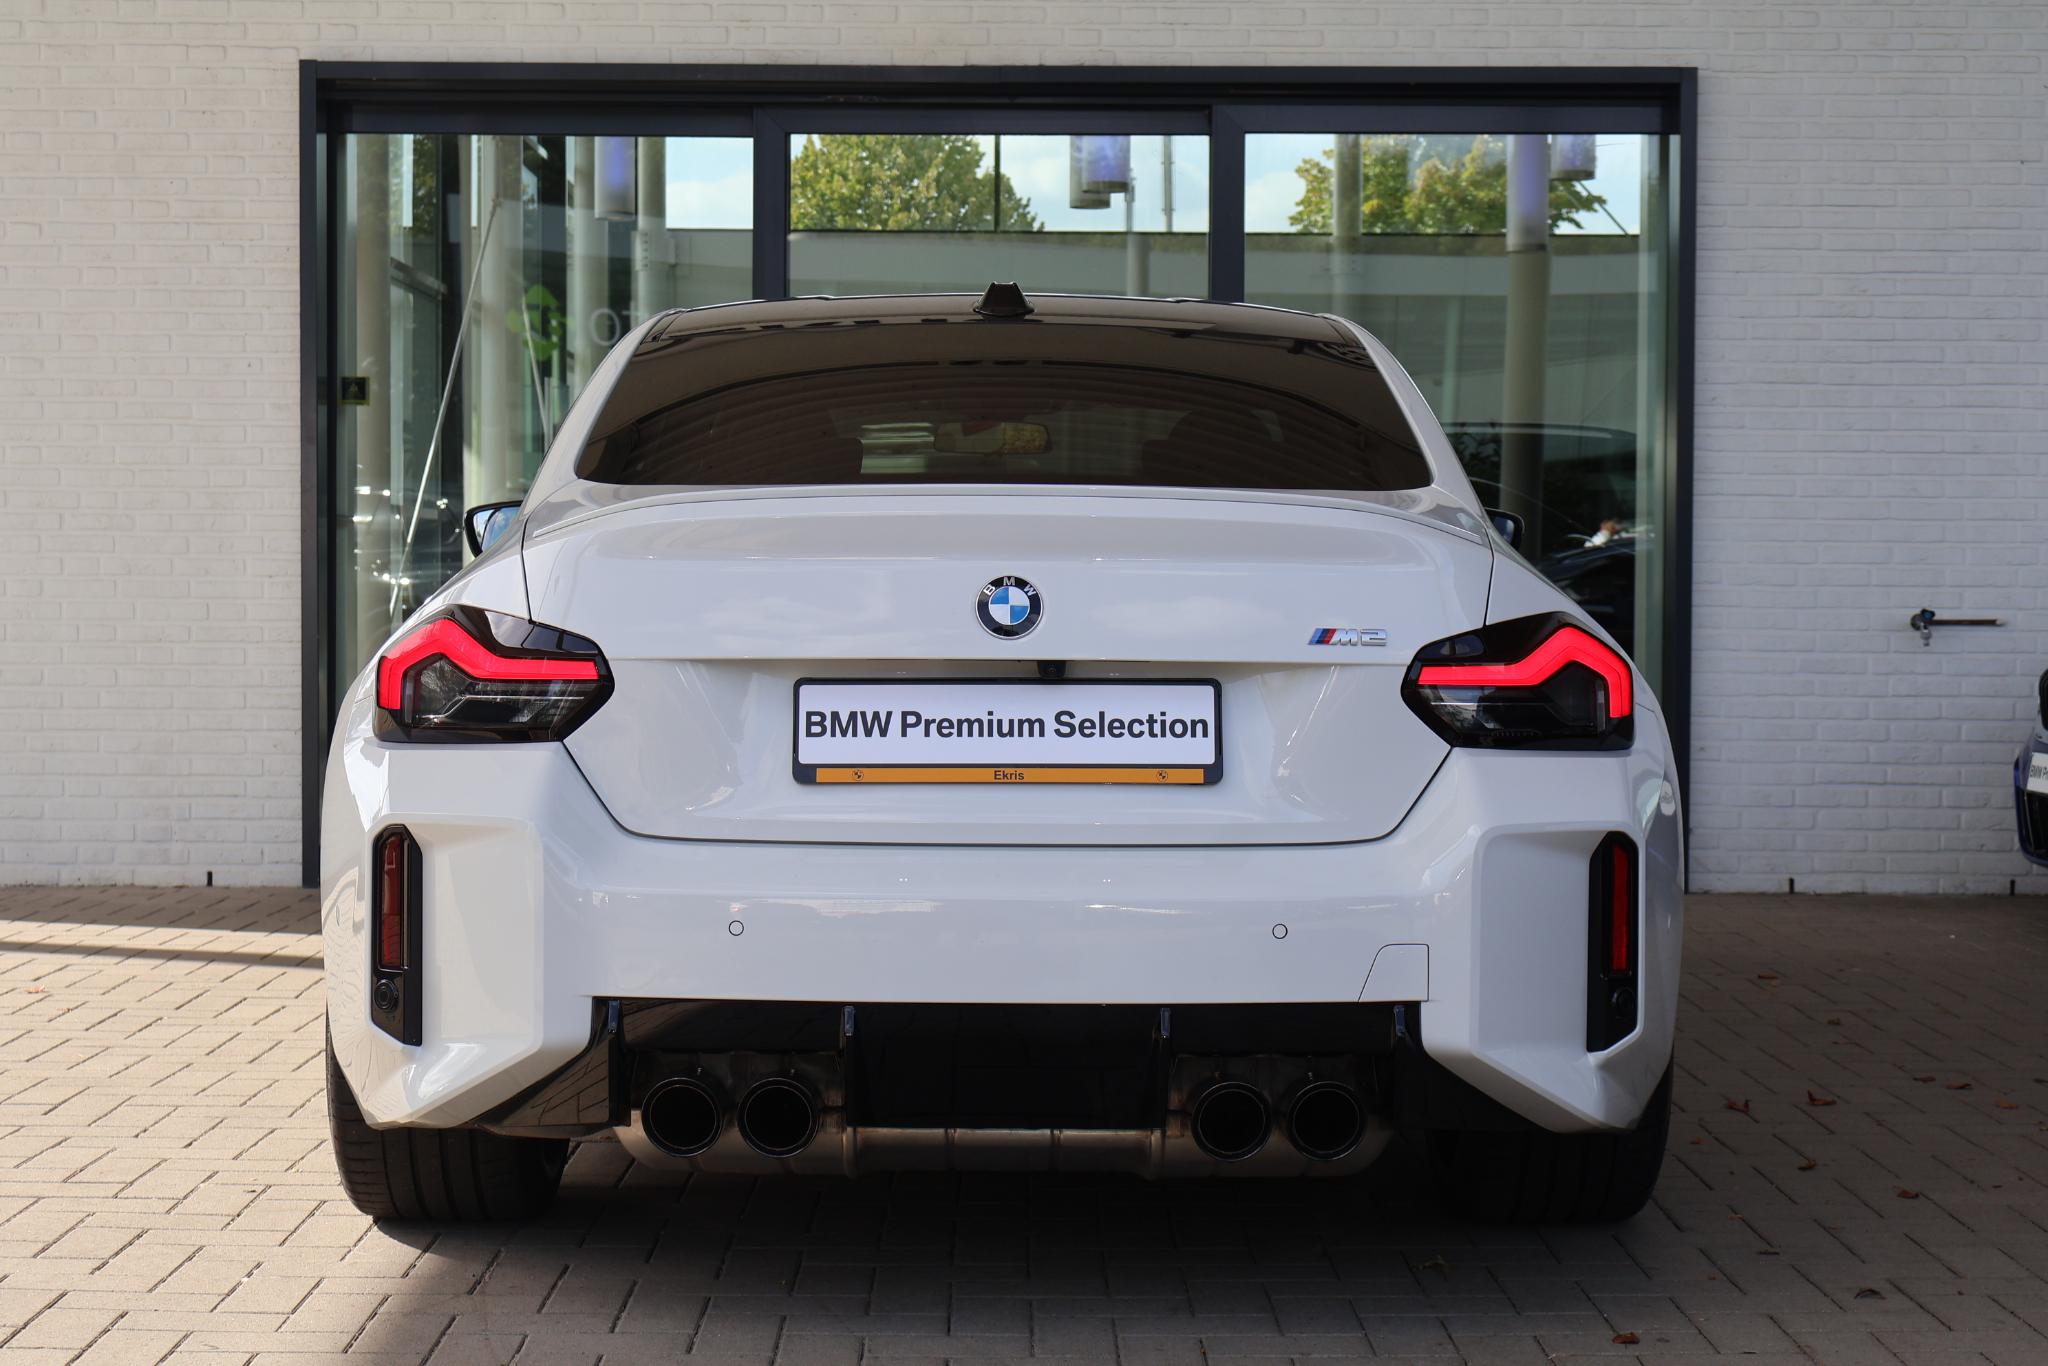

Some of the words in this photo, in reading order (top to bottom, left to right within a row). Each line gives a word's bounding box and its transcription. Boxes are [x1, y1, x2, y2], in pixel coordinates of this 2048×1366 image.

[983, 576, 1036, 596] BMW
[804, 709, 893, 739] BMW
[900, 709, 1046, 739] Premium
[1053, 709, 1210, 739] Selection
[993, 769, 1026, 781] Ekris
